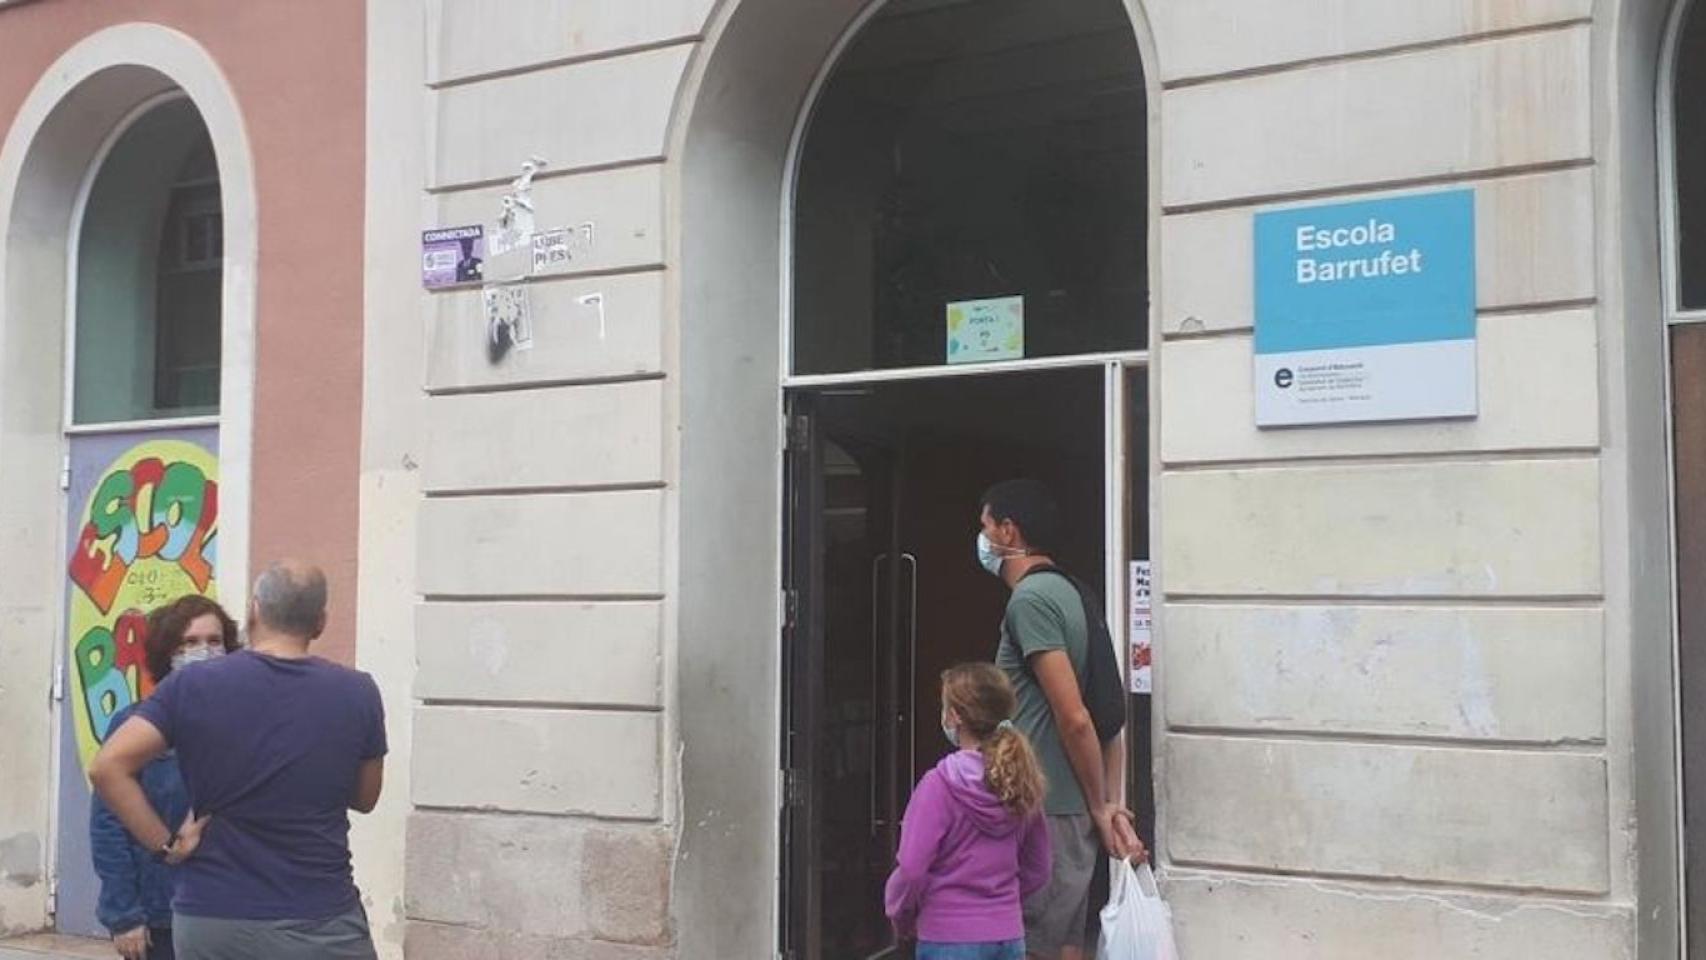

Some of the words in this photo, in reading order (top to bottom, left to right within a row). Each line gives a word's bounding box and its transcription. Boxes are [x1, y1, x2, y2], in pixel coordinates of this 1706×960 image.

[1296, 218, 1395, 252] Escola
[1296, 248, 1422, 284] Barrufet
[1274, 367, 1294, 389] e
[69, 457, 219, 617] ESCOL
